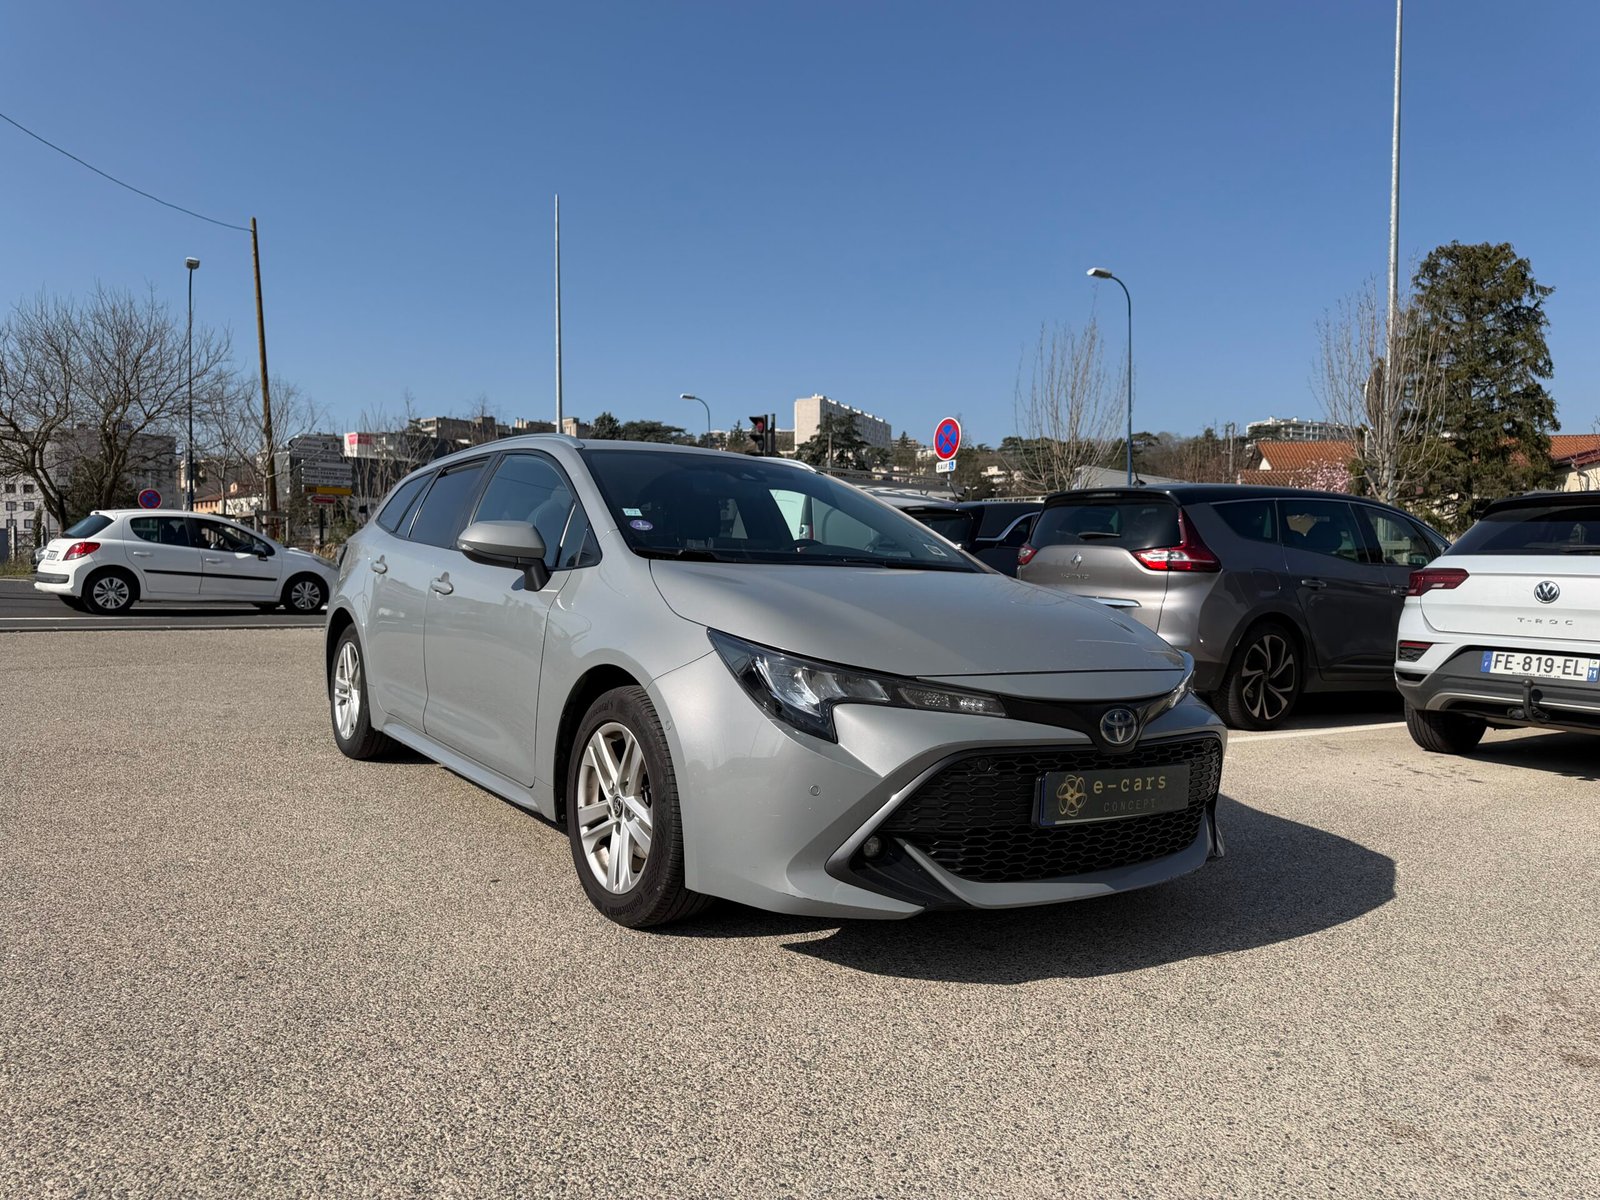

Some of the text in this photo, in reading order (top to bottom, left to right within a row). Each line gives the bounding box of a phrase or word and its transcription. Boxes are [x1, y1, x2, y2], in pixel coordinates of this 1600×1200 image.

[1517, 617, 1573, 626] T-ROC
[1493, 654, 1584, 677] FE-819-EL
[1093, 775, 1167, 794] e-cars
[1103, 798, 1156, 813] CONCEPT
